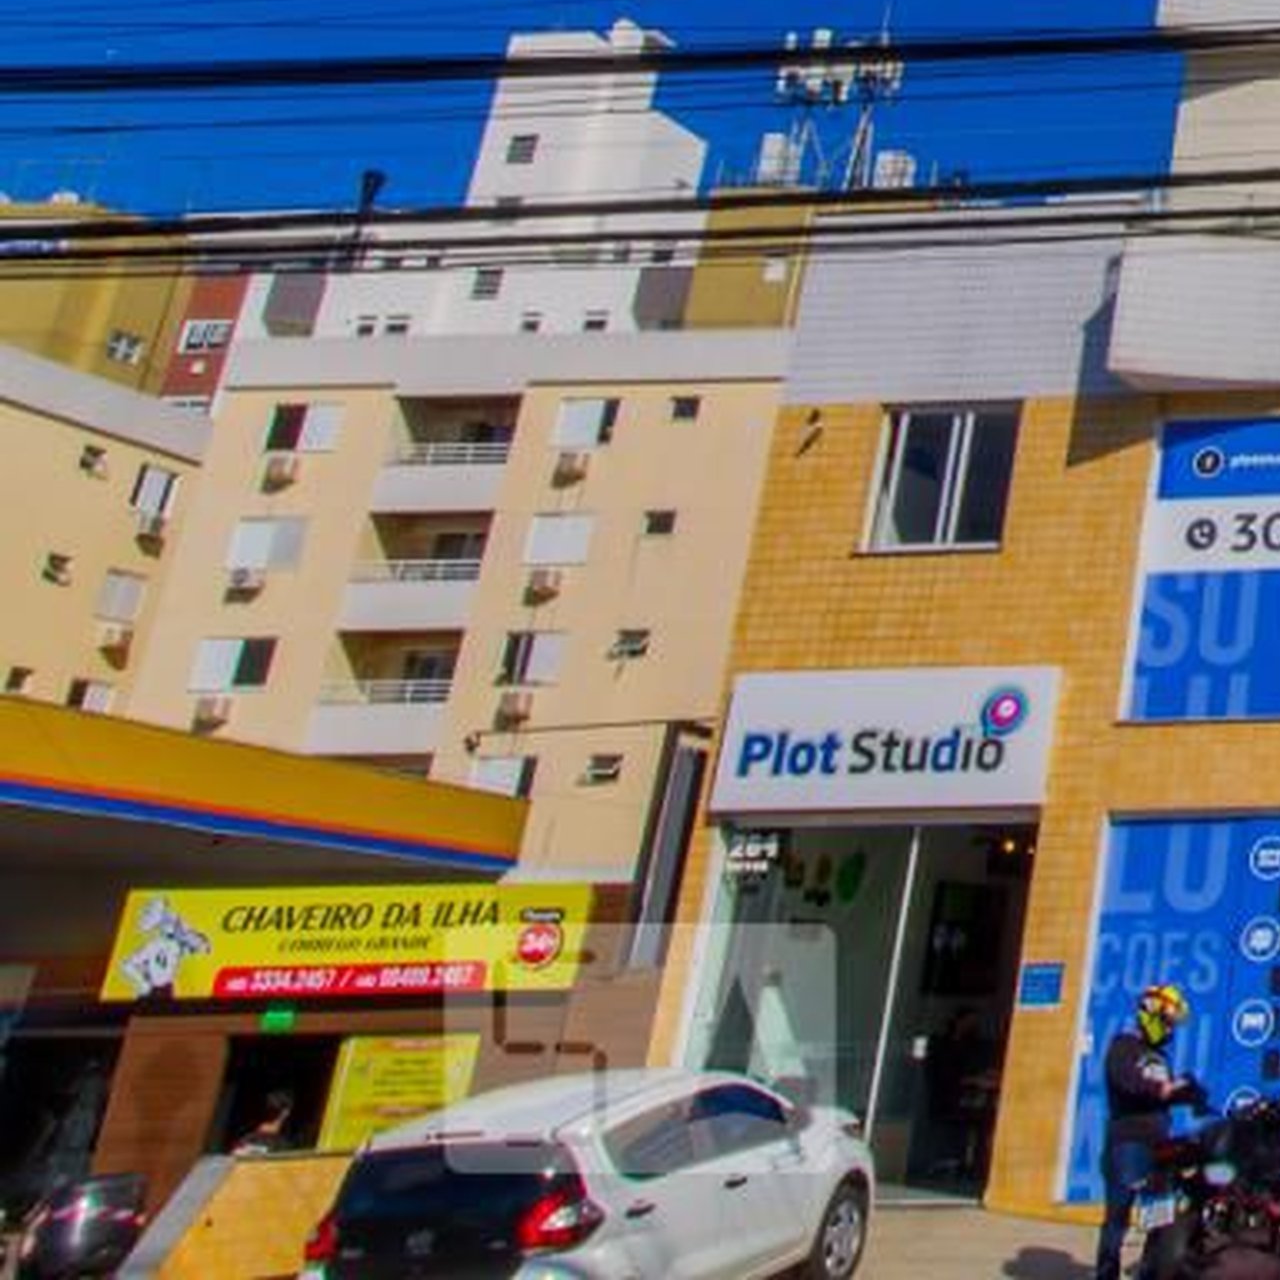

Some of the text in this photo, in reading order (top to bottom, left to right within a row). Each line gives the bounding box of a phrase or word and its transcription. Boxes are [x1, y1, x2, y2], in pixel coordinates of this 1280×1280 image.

[736, 727, 1005, 777] Plot Studio
[221, 904, 374, 933] CHAVEIRO
[382, 902, 424, 929] DA
[430, 900, 500, 927] ILHA
